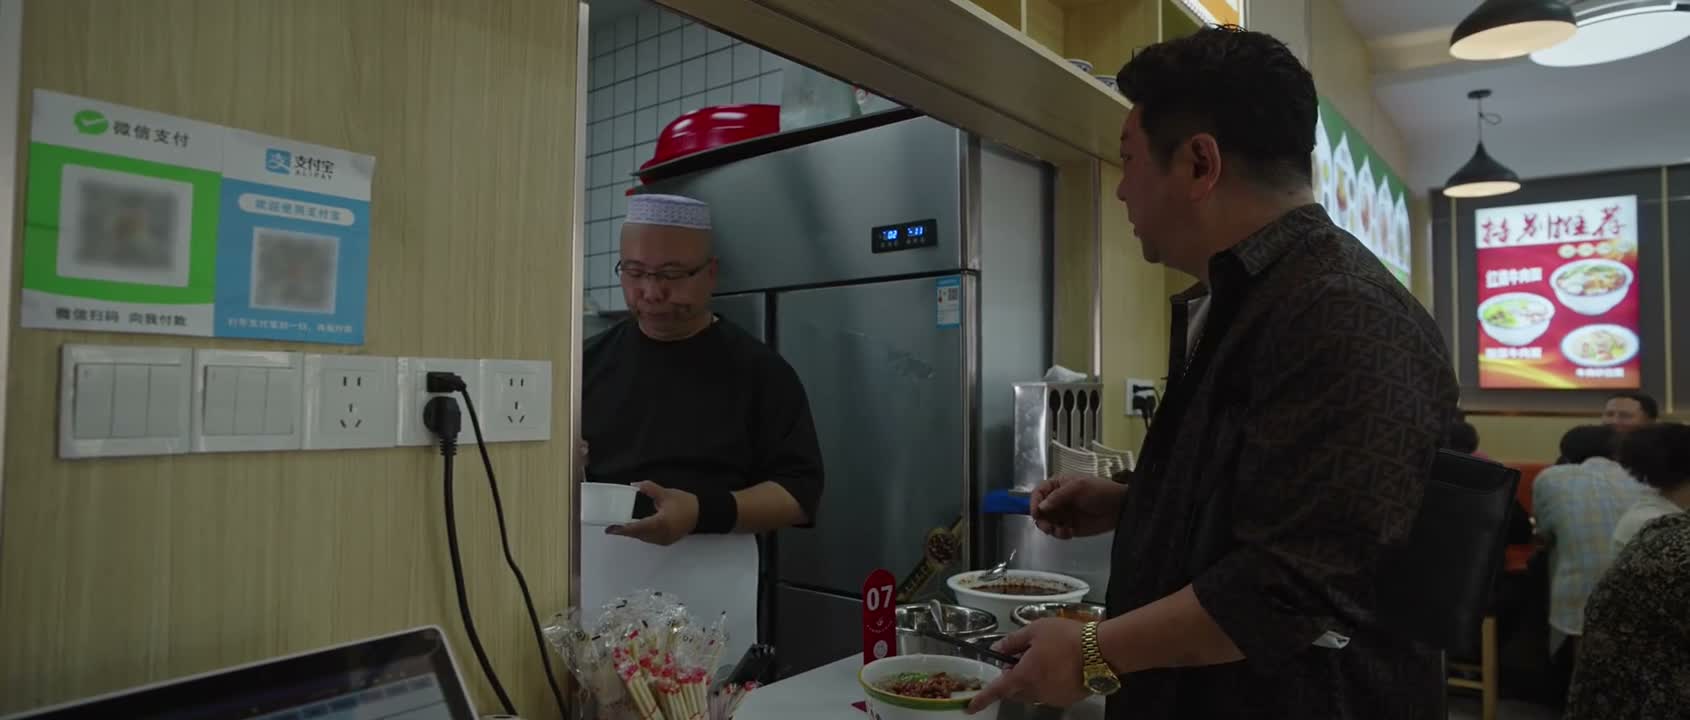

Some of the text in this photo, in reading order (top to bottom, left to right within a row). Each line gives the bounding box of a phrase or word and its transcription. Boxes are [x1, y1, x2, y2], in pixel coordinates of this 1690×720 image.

[113, 120, 189, 148] 微信支付
[295, 155, 334, 175] 支付宝
[1480, 206, 1627, 244] 特别推荐
[56, 307, 188, 327] 微信扫码 向我付款
[866, 585, 893, 611] 07
